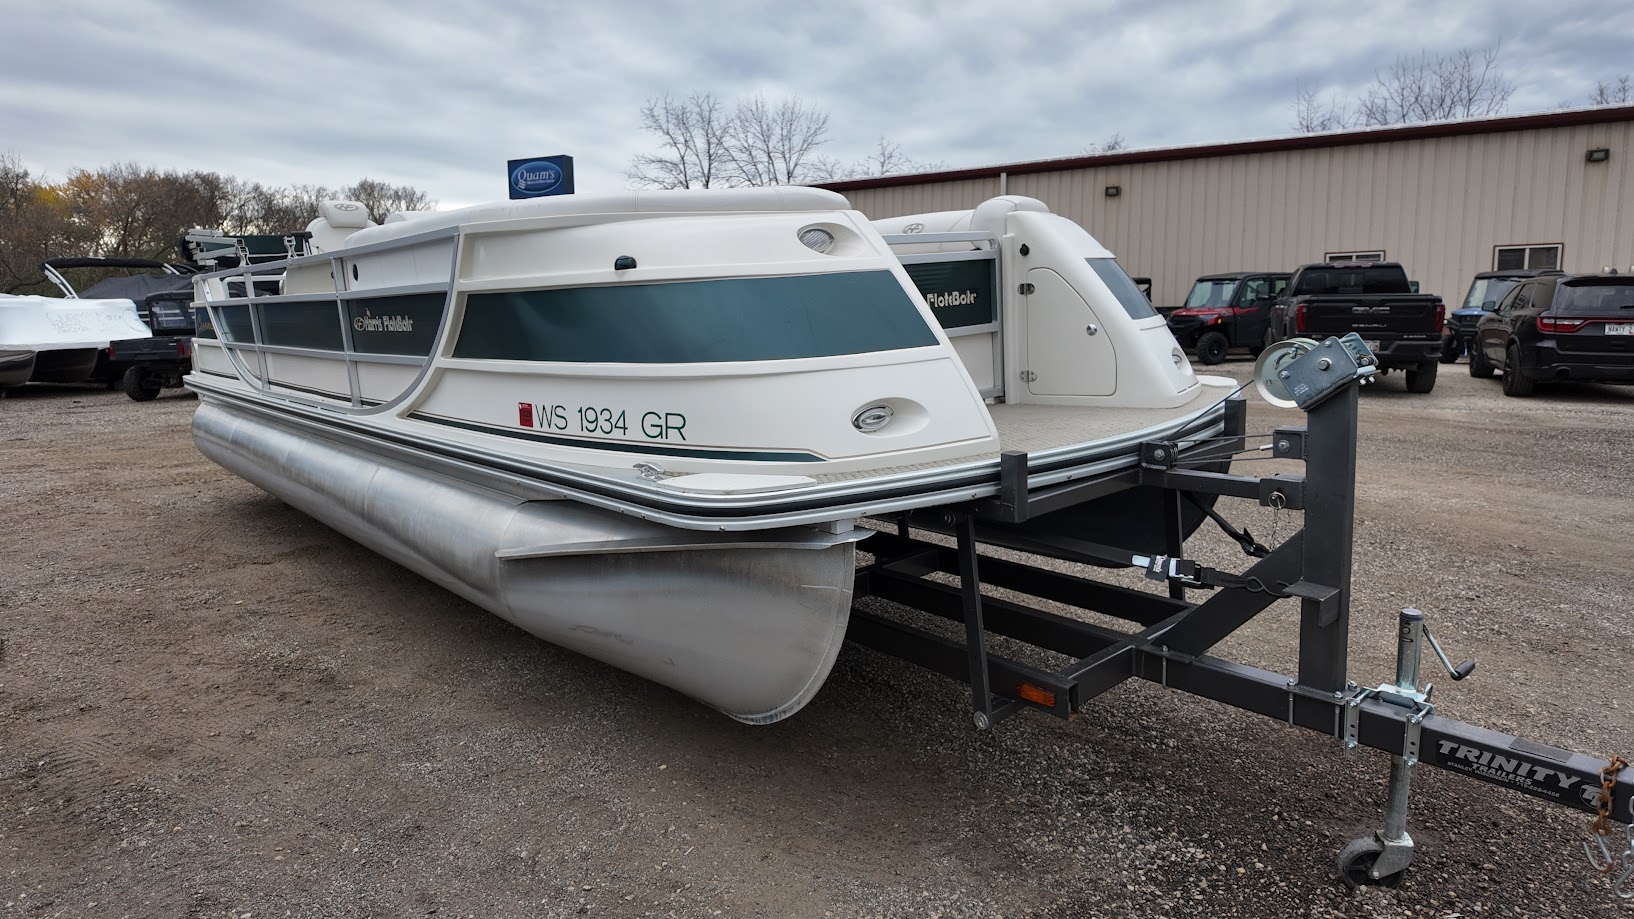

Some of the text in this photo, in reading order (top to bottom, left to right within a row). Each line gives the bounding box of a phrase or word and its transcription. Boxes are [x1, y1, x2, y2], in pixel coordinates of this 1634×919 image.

[517, 169, 555, 181] Quam's
[364, 315, 383, 331] Harris
[535, 404, 568, 430] WS
[577, 406, 628, 435] 1934
[641, 411, 686, 440] GR
[1438, 740, 1582, 789] TRINITY
[1447, 761, 1474, 773] STANLEY,
[1471, 763, 1533, 785] TRAILERS
